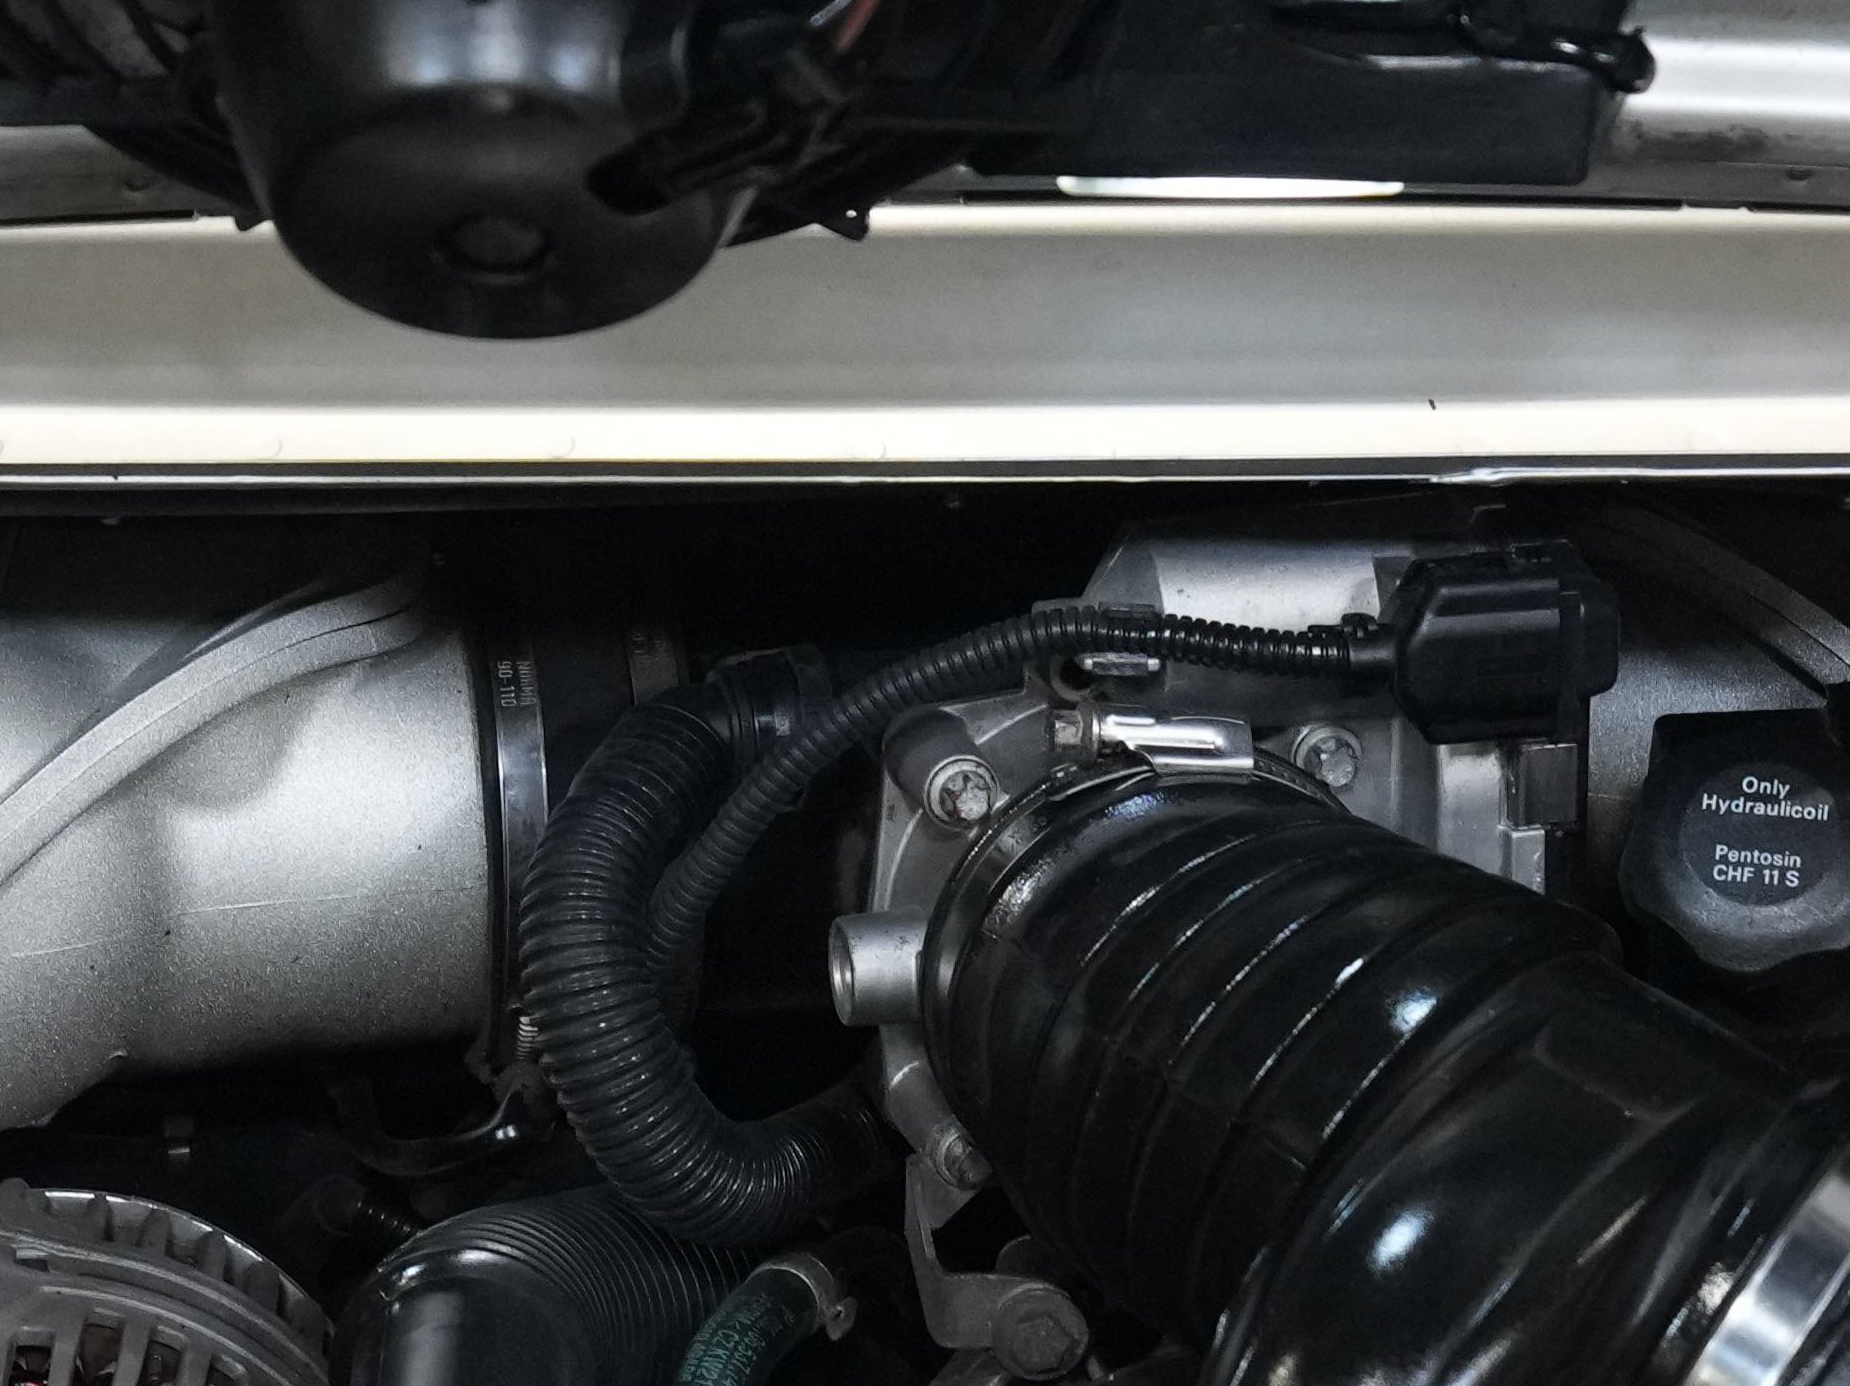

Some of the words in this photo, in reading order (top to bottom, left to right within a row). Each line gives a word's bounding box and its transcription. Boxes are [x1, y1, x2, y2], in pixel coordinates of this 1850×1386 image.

[497, 661, 517, 707] 90-110
[1740, 775, 1790, 800] Only
[1701, 792, 1830, 821] Hydraulicoil
[1714, 844, 1802, 868] Pentosin
[1712, 864, 1755, 883] CHF
[1763, 869, 1780, 885] 11
[1785, 871, 1800, 889] S
